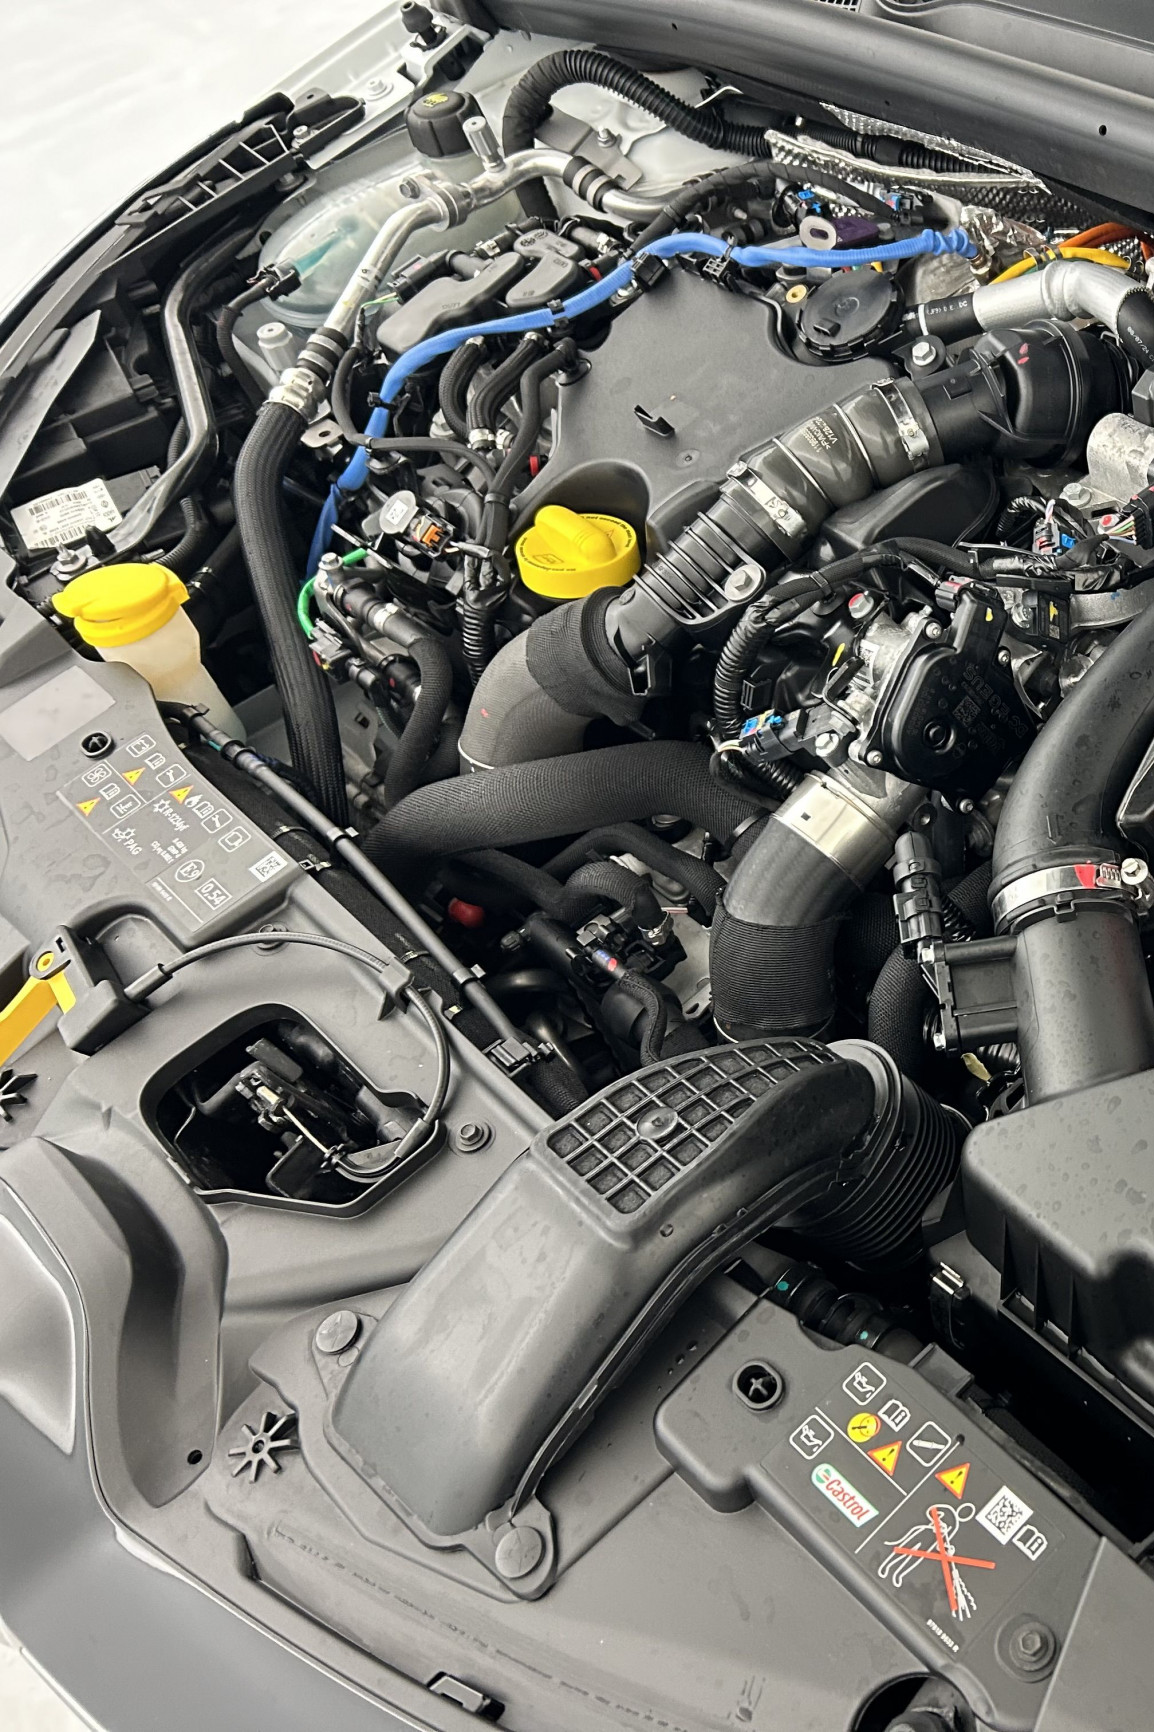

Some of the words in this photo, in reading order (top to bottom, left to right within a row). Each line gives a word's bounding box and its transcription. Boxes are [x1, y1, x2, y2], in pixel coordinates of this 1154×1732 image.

[161, 805, 189, 833] R-1234yf
[122, 836, 143, 856] PAG
[180, 865, 201, 880] E9
[198, 881, 226, 906] 0,54
[824, 1476, 870, 1521] Castrol
